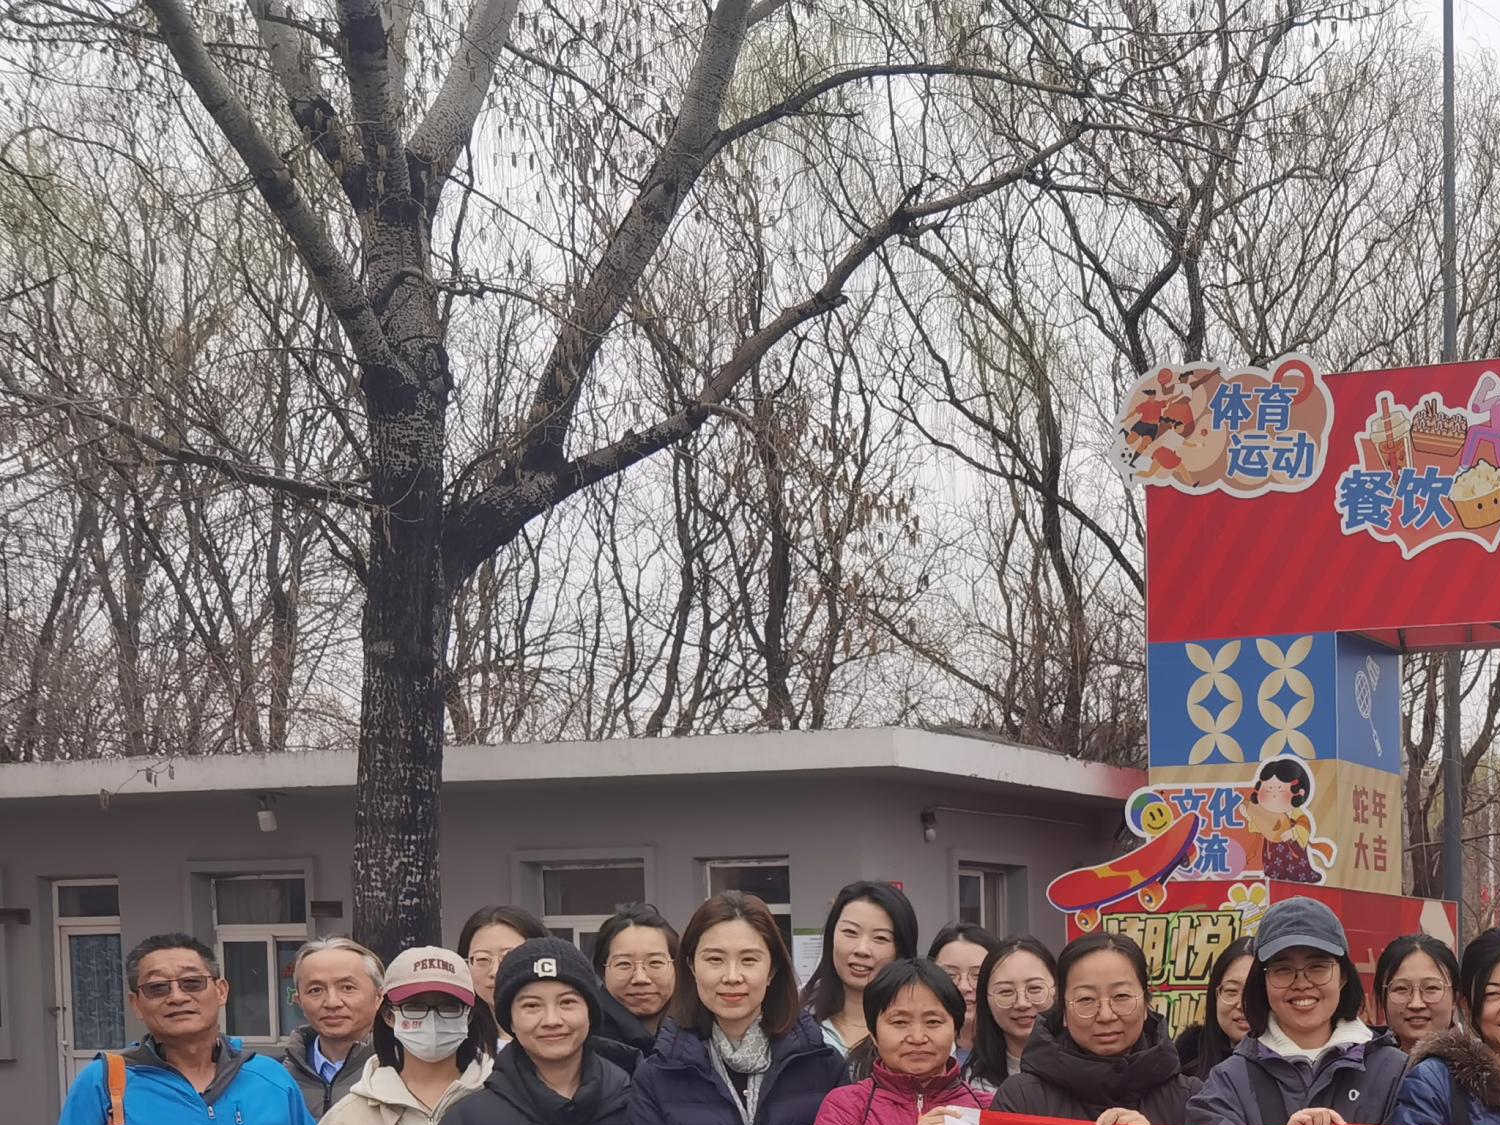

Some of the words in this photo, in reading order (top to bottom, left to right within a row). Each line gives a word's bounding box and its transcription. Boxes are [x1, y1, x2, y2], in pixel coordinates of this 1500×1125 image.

[1209, 383, 1297, 433] 体育
[1228, 434, 1314, 479] 运动
[1339, 468, 1455, 531] 餐饮
[1353, 785, 1388, 828] 蛇年
[1354, 835, 1387, 872] 大吉
[413, 958, 456, 974] PEKING
